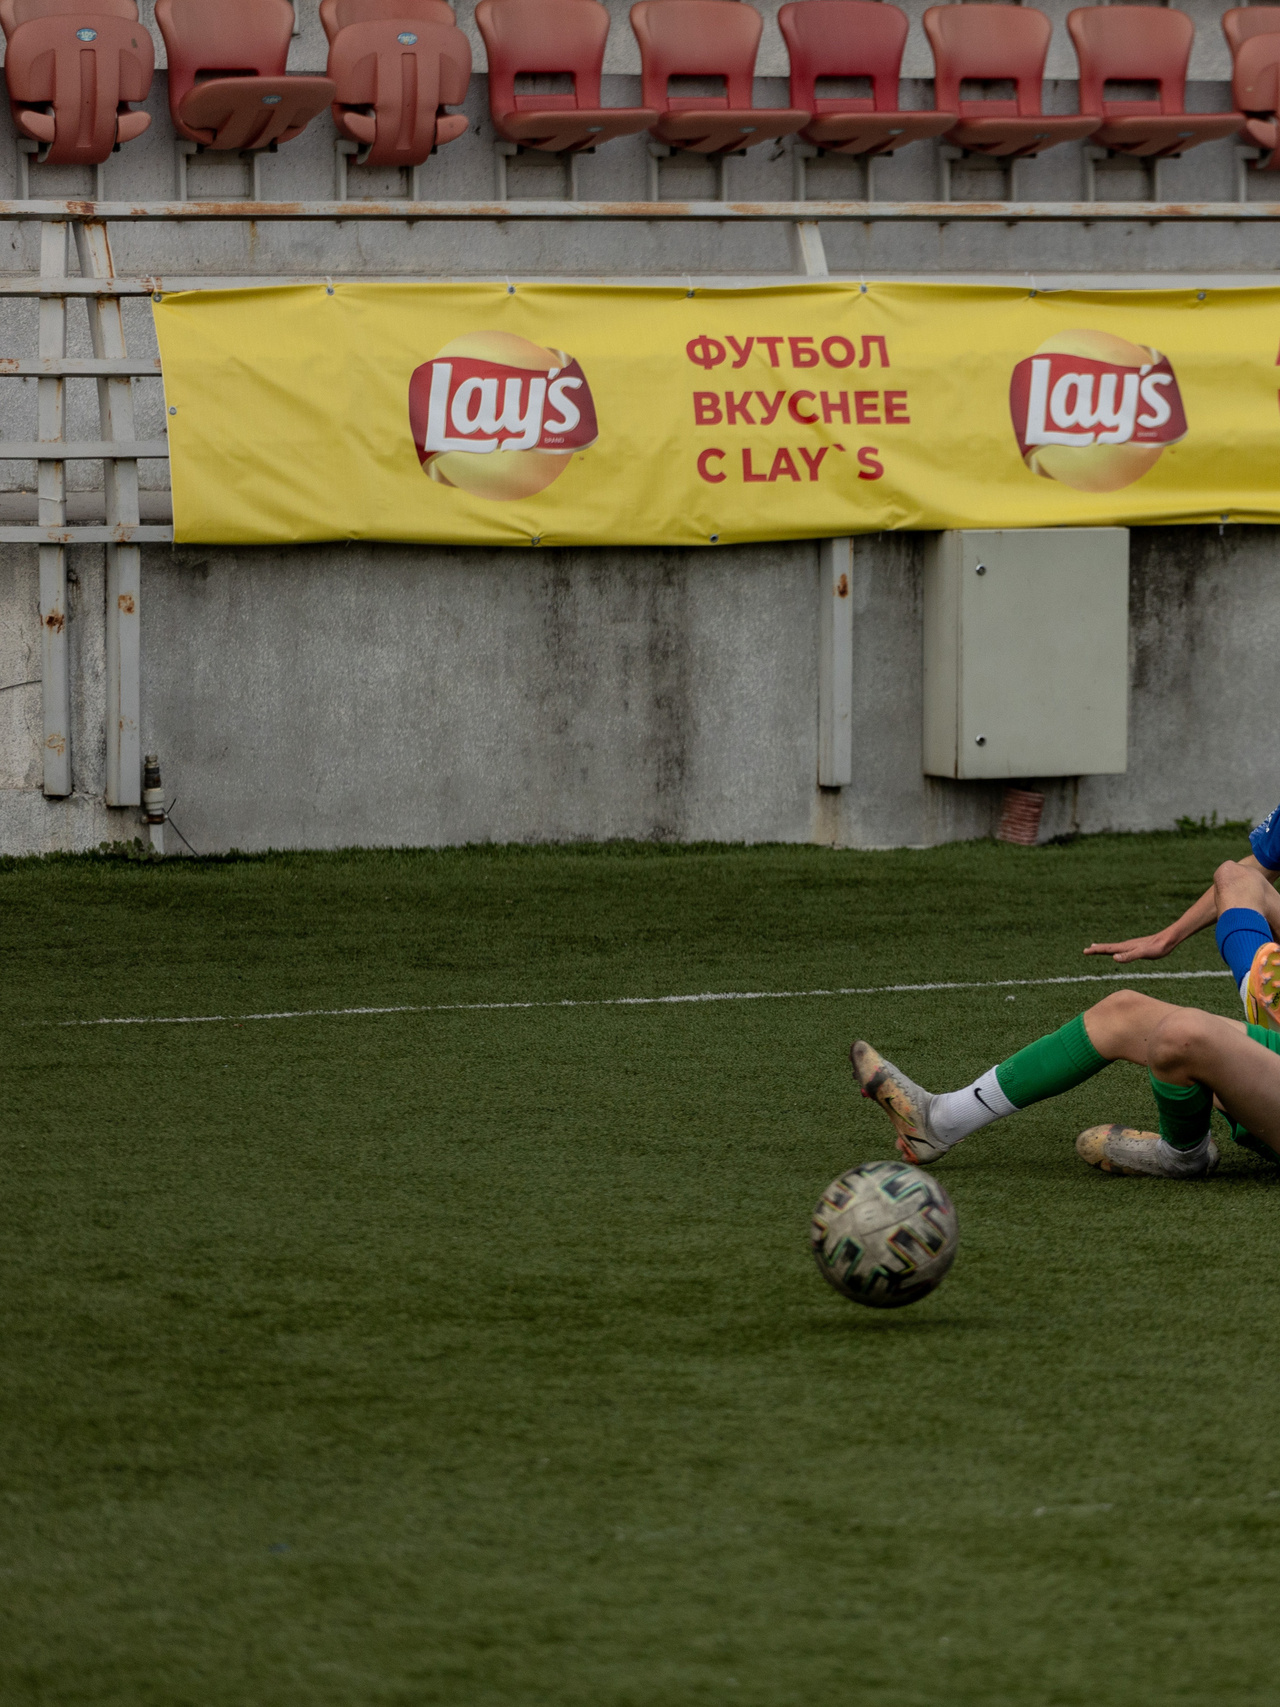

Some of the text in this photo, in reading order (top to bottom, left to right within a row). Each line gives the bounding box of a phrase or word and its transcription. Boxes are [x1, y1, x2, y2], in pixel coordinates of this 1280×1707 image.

[685, 334, 891, 370] ФУТБОЛ
[424, 362, 583, 454] Lay's
[692, 389, 911, 426] ВКУСНЕЕ
[1025, 358, 1173, 448] Lay's
[696, 447, 727, 484] С
